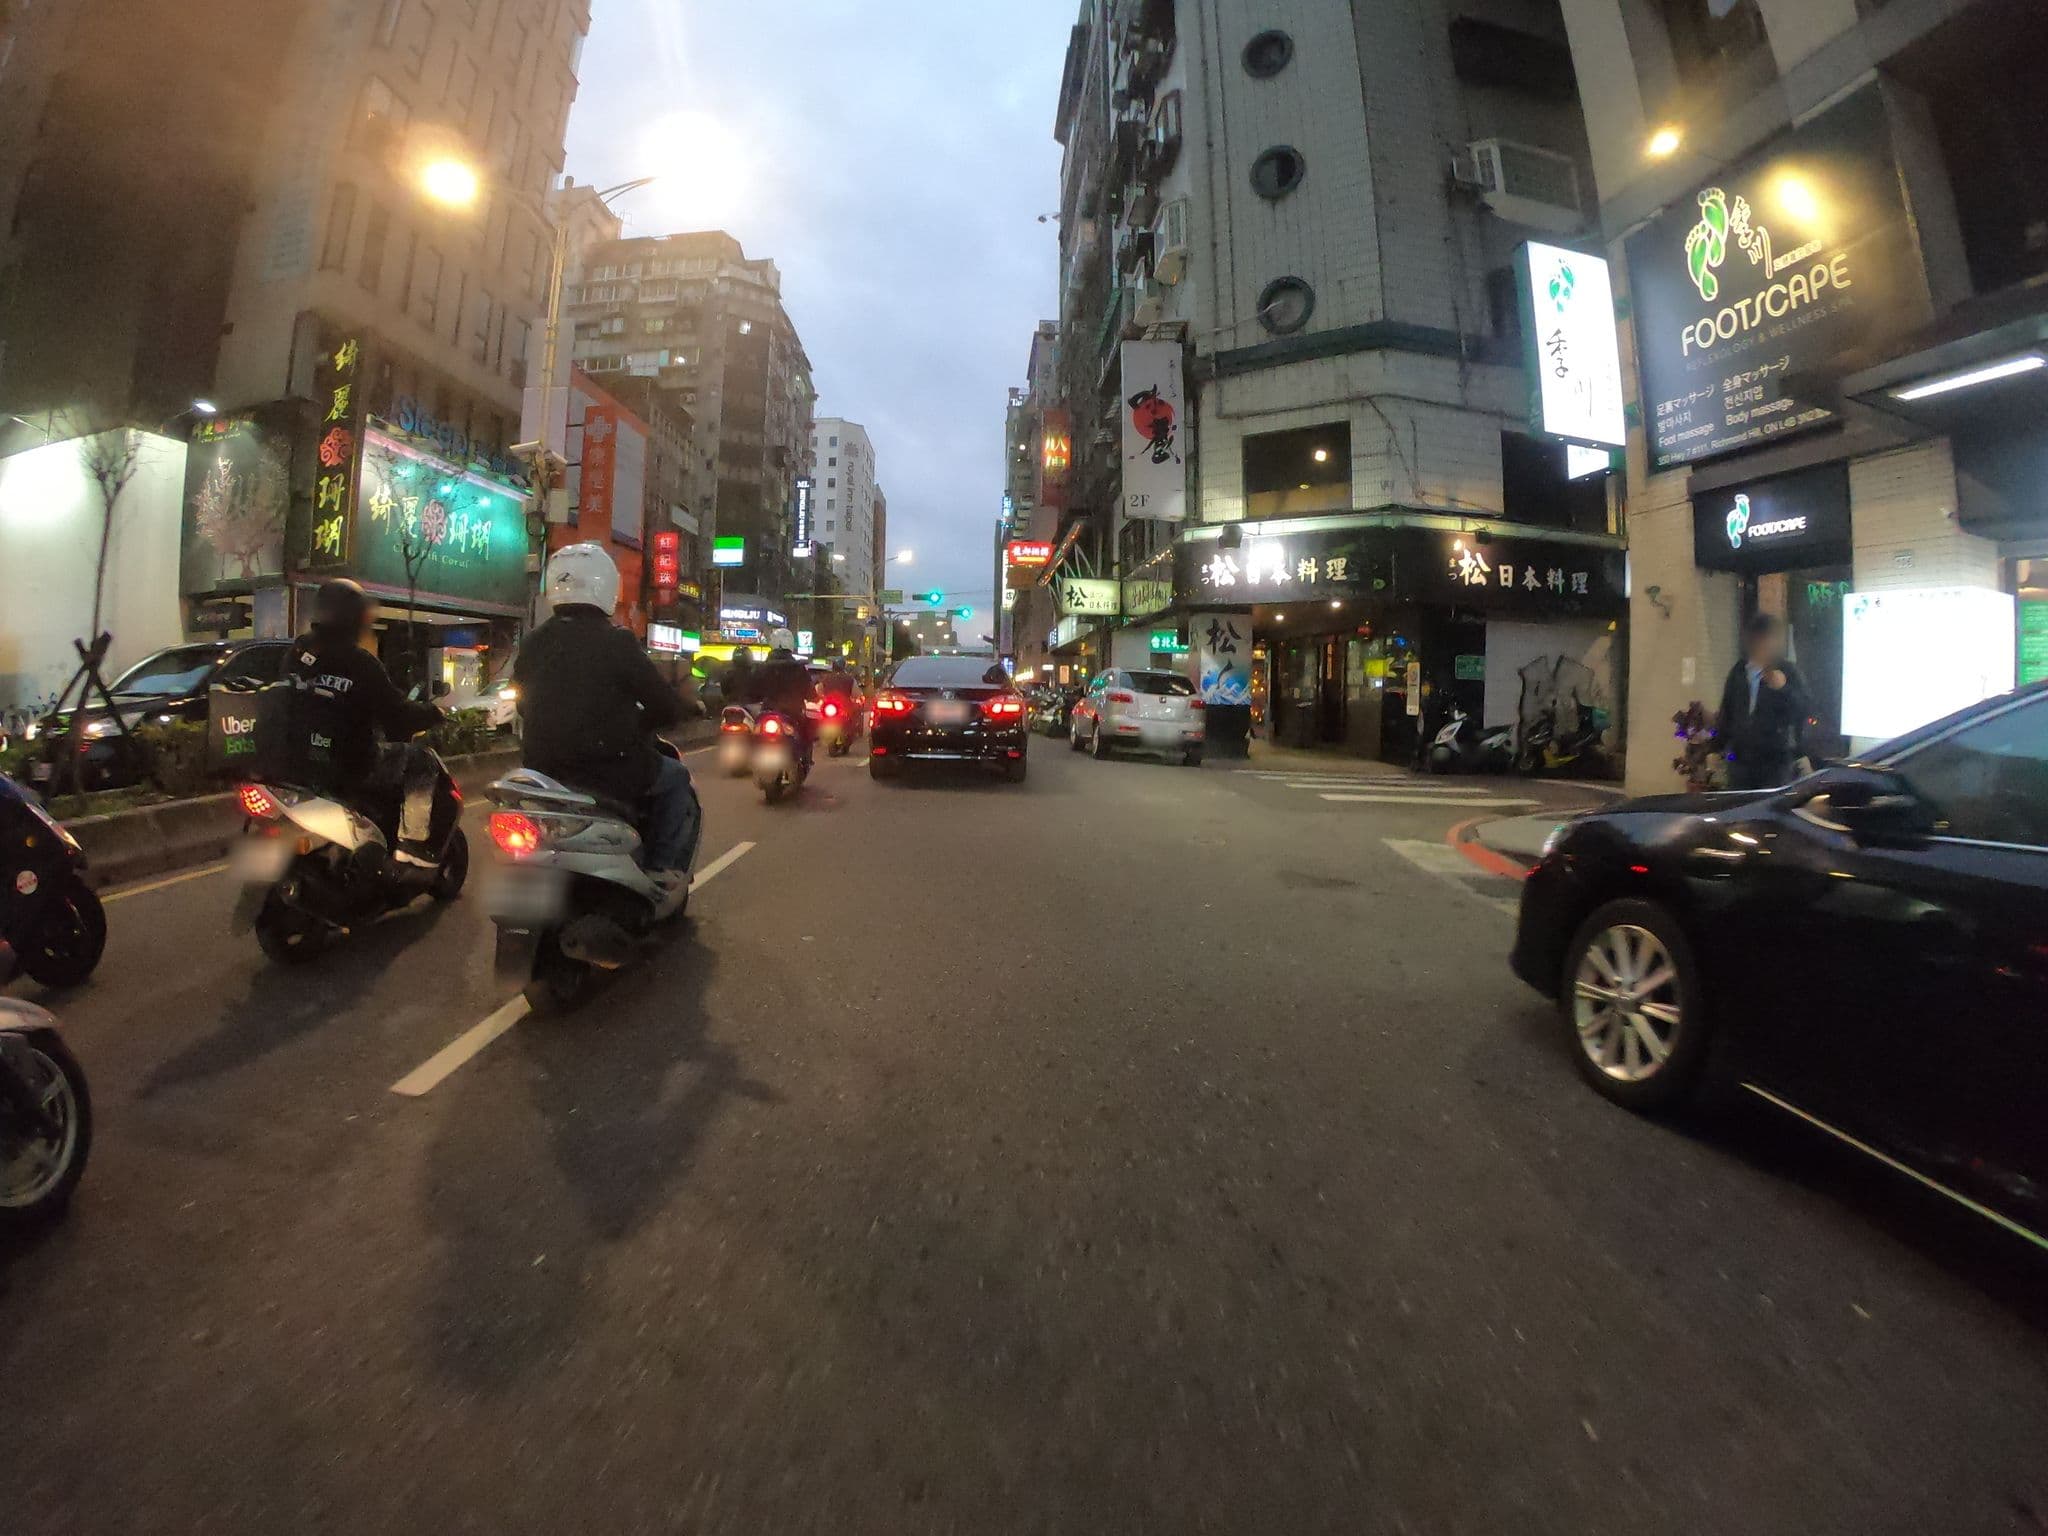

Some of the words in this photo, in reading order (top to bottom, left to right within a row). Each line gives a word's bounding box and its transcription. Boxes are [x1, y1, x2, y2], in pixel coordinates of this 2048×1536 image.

[1682, 254, 1852, 356] FOOTSCAPE
[1725, 410, 1750, 426] Body
[1751, 398, 1794, 418] massage
[1677, 422, 1715, 442] massage
[1130, 494, 1150, 508] 2F
[1066, 585, 1088, 608] 松
[1206, 618, 1247, 655] 松
[221, 716, 257, 735] Uber
[310, 733, 333, 748] Uber
